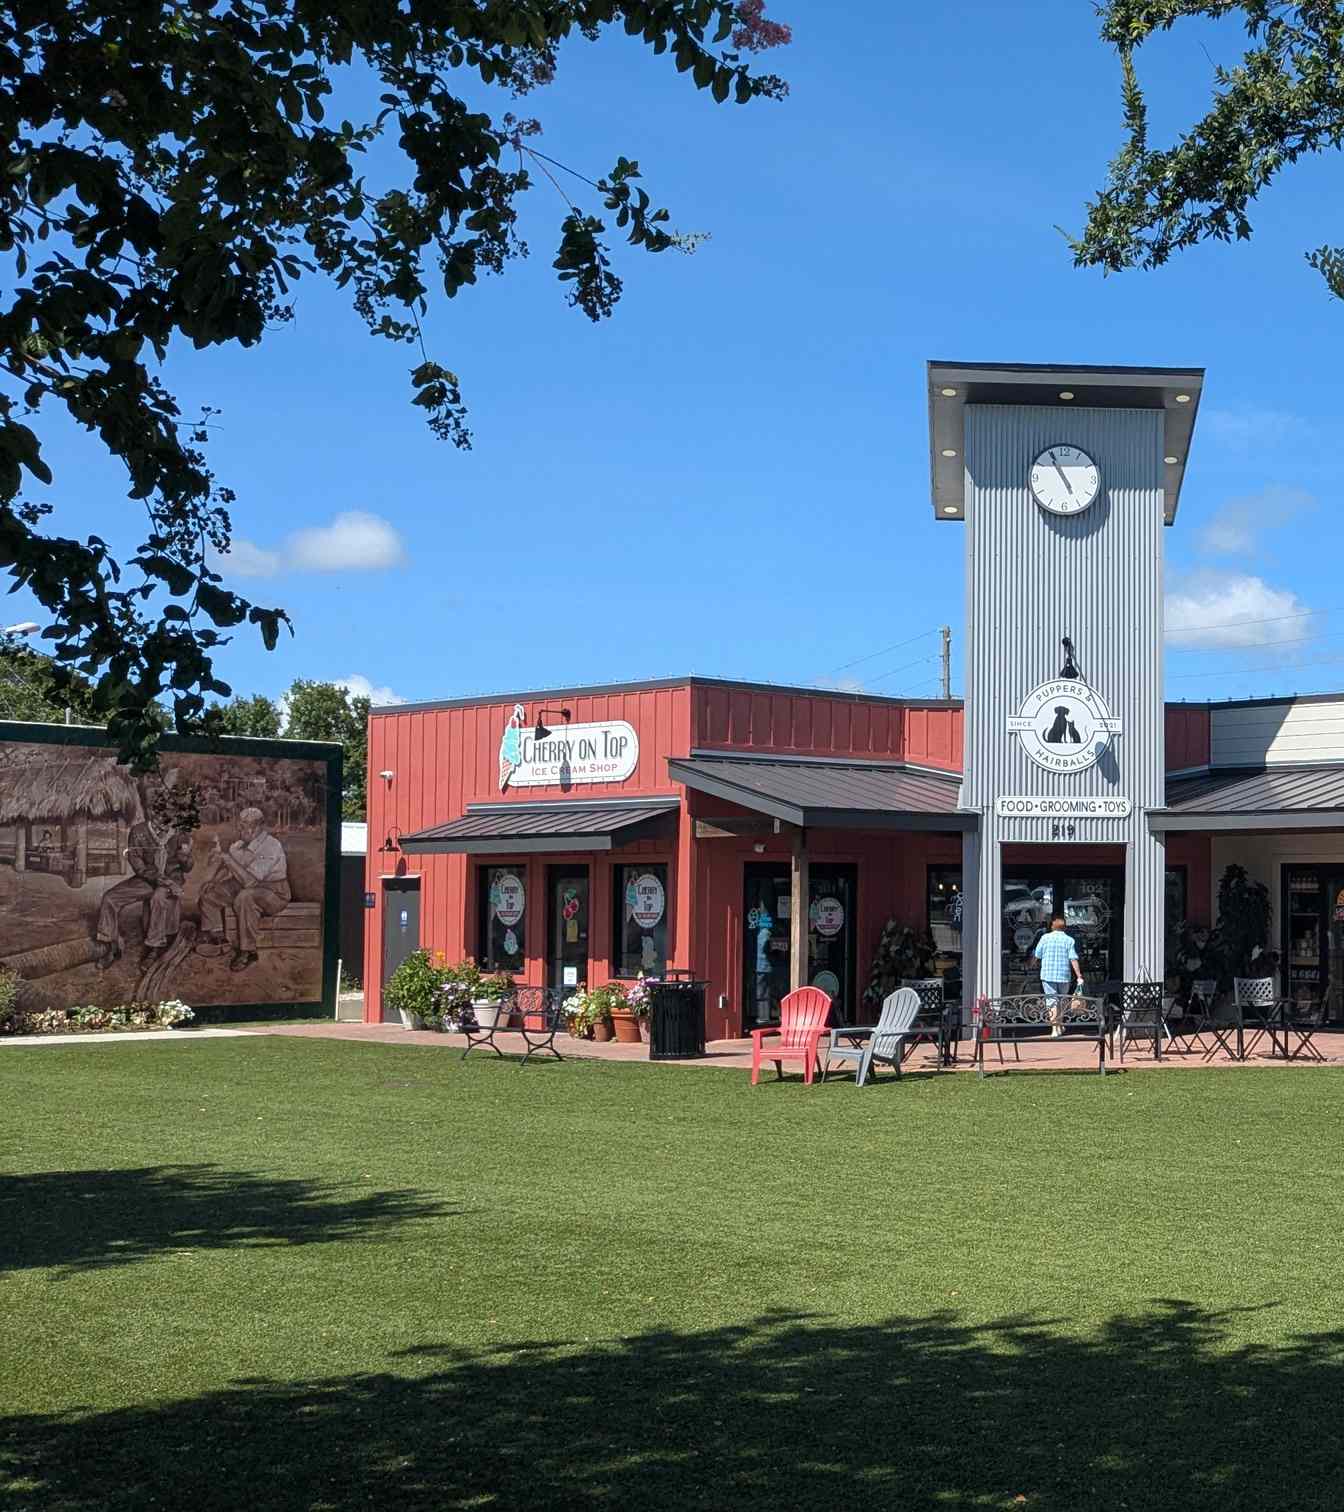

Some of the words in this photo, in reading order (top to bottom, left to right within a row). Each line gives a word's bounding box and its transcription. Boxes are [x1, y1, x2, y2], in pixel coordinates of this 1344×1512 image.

[1058, 447, 1071, 457] 12
[1032, 473, 1039, 483] 9
[1090, 475, 1097, 486] 3
[1061, 502, 1068, 511] 6
[1036, 685, 1084, 703] PUPPERS
[1085, 695, 1093, 703] &
[1010, 720, 1033, 728] SINCE
[578, 738, 596, 760] ON
[1035, 749, 1096, 769] HAIRBALLS
[531, 766, 548, 777] ICE
[550, 765, 586, 776] CREAM
[589, 763, 619, 774] SHOP
[1001, 800, 1035, 813] FOOD
[1040, 800, 1097, 813] GROOMING
[1104, 800, 1127, 813] TOYS
